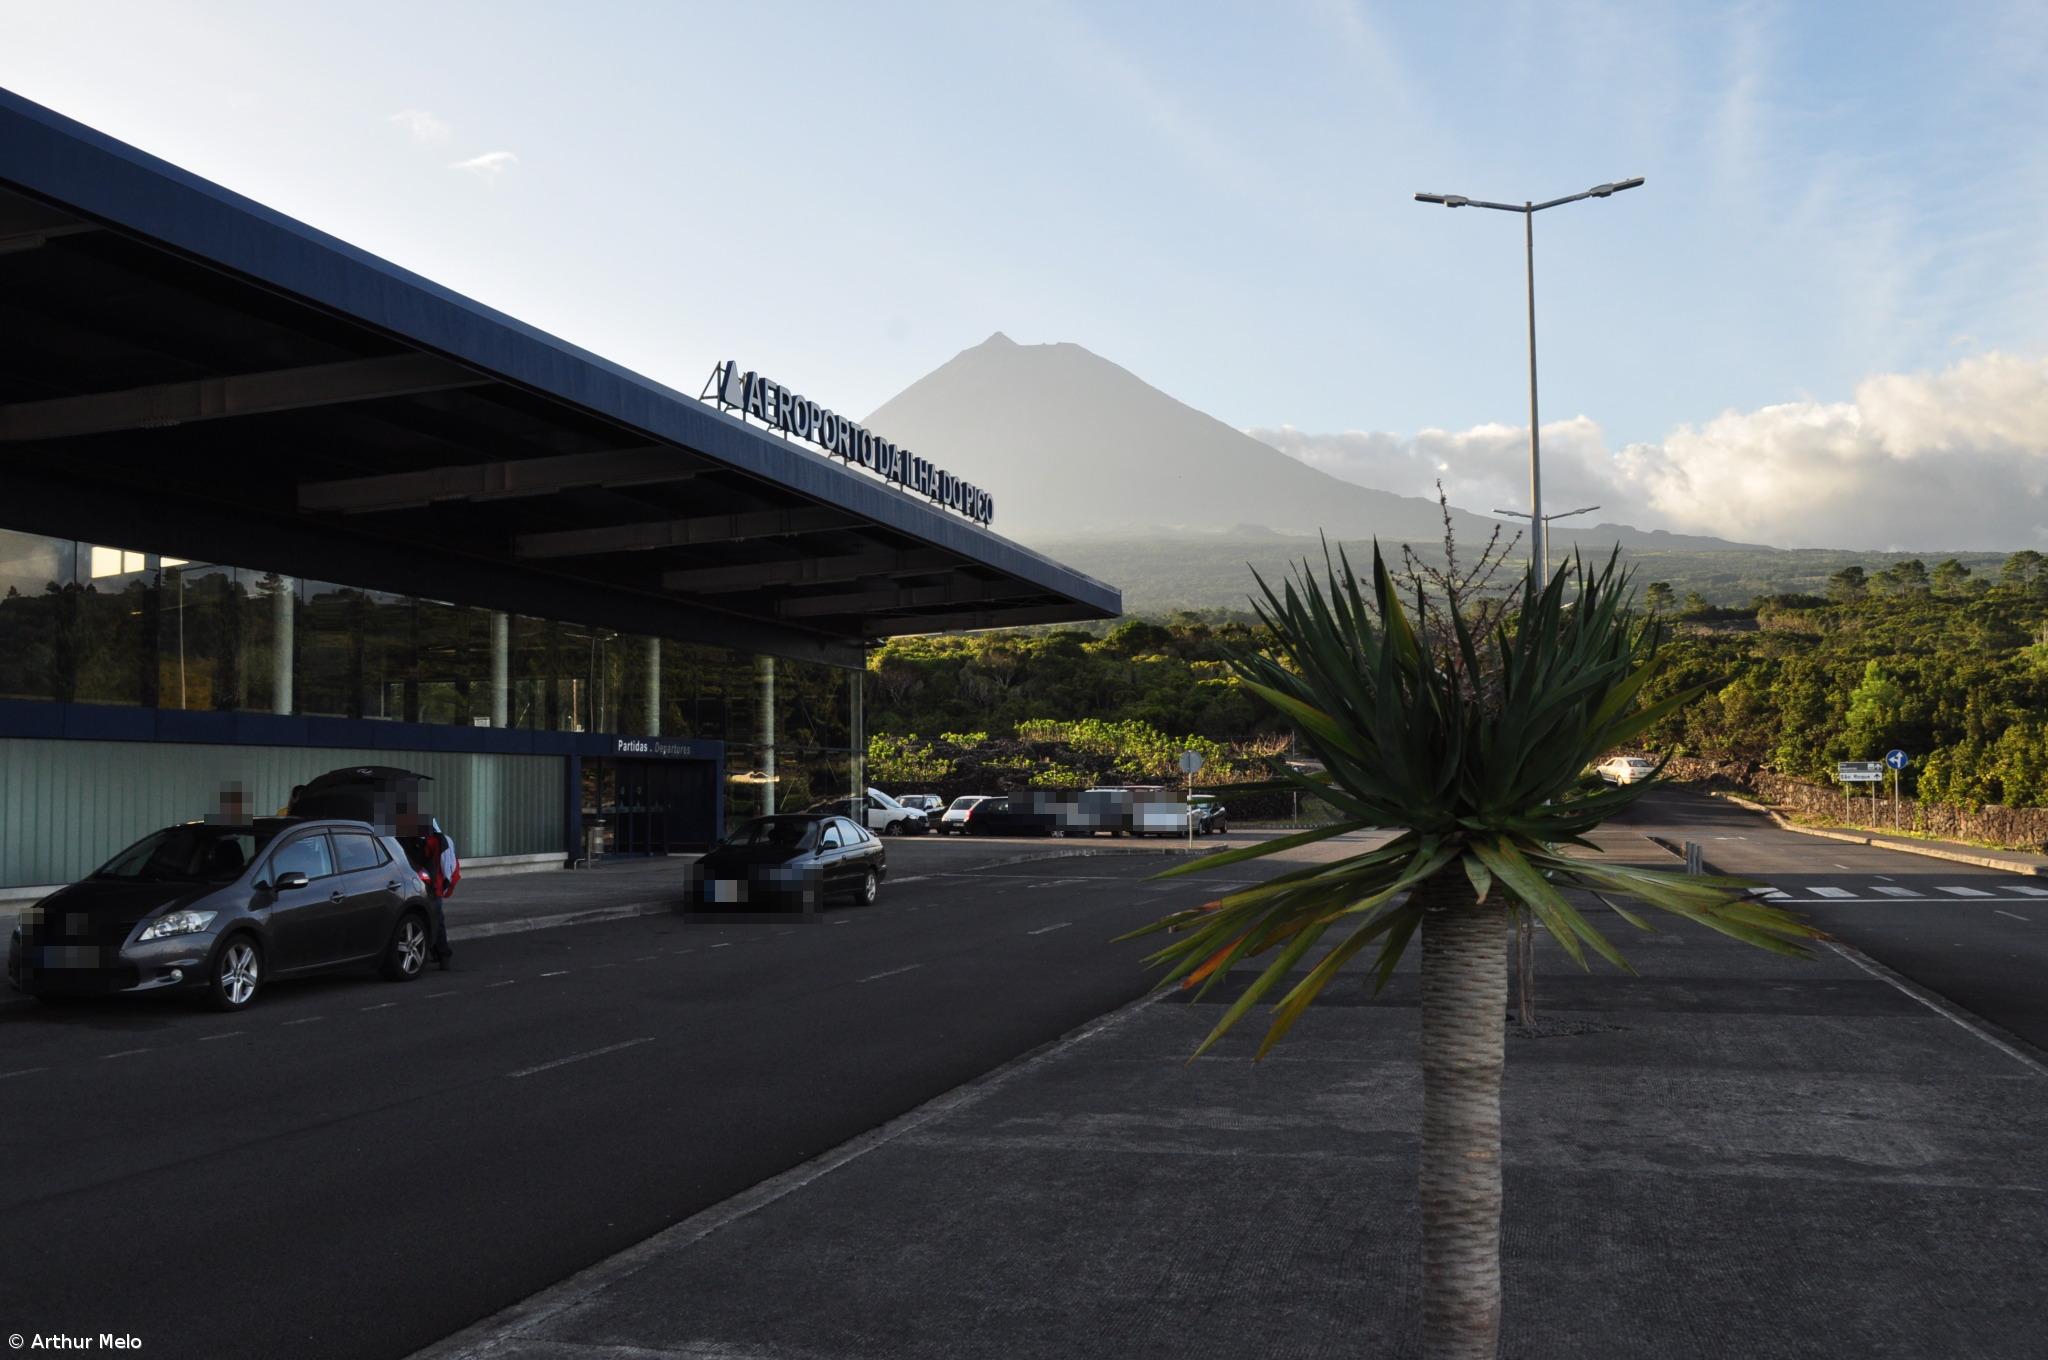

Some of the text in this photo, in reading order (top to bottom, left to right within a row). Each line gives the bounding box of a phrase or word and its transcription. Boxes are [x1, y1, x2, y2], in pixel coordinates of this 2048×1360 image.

[744, 371, 993, 525] AEROPORTO DA ILHA DO PICO
[618, 739, 690, 756] Partidas Departures
